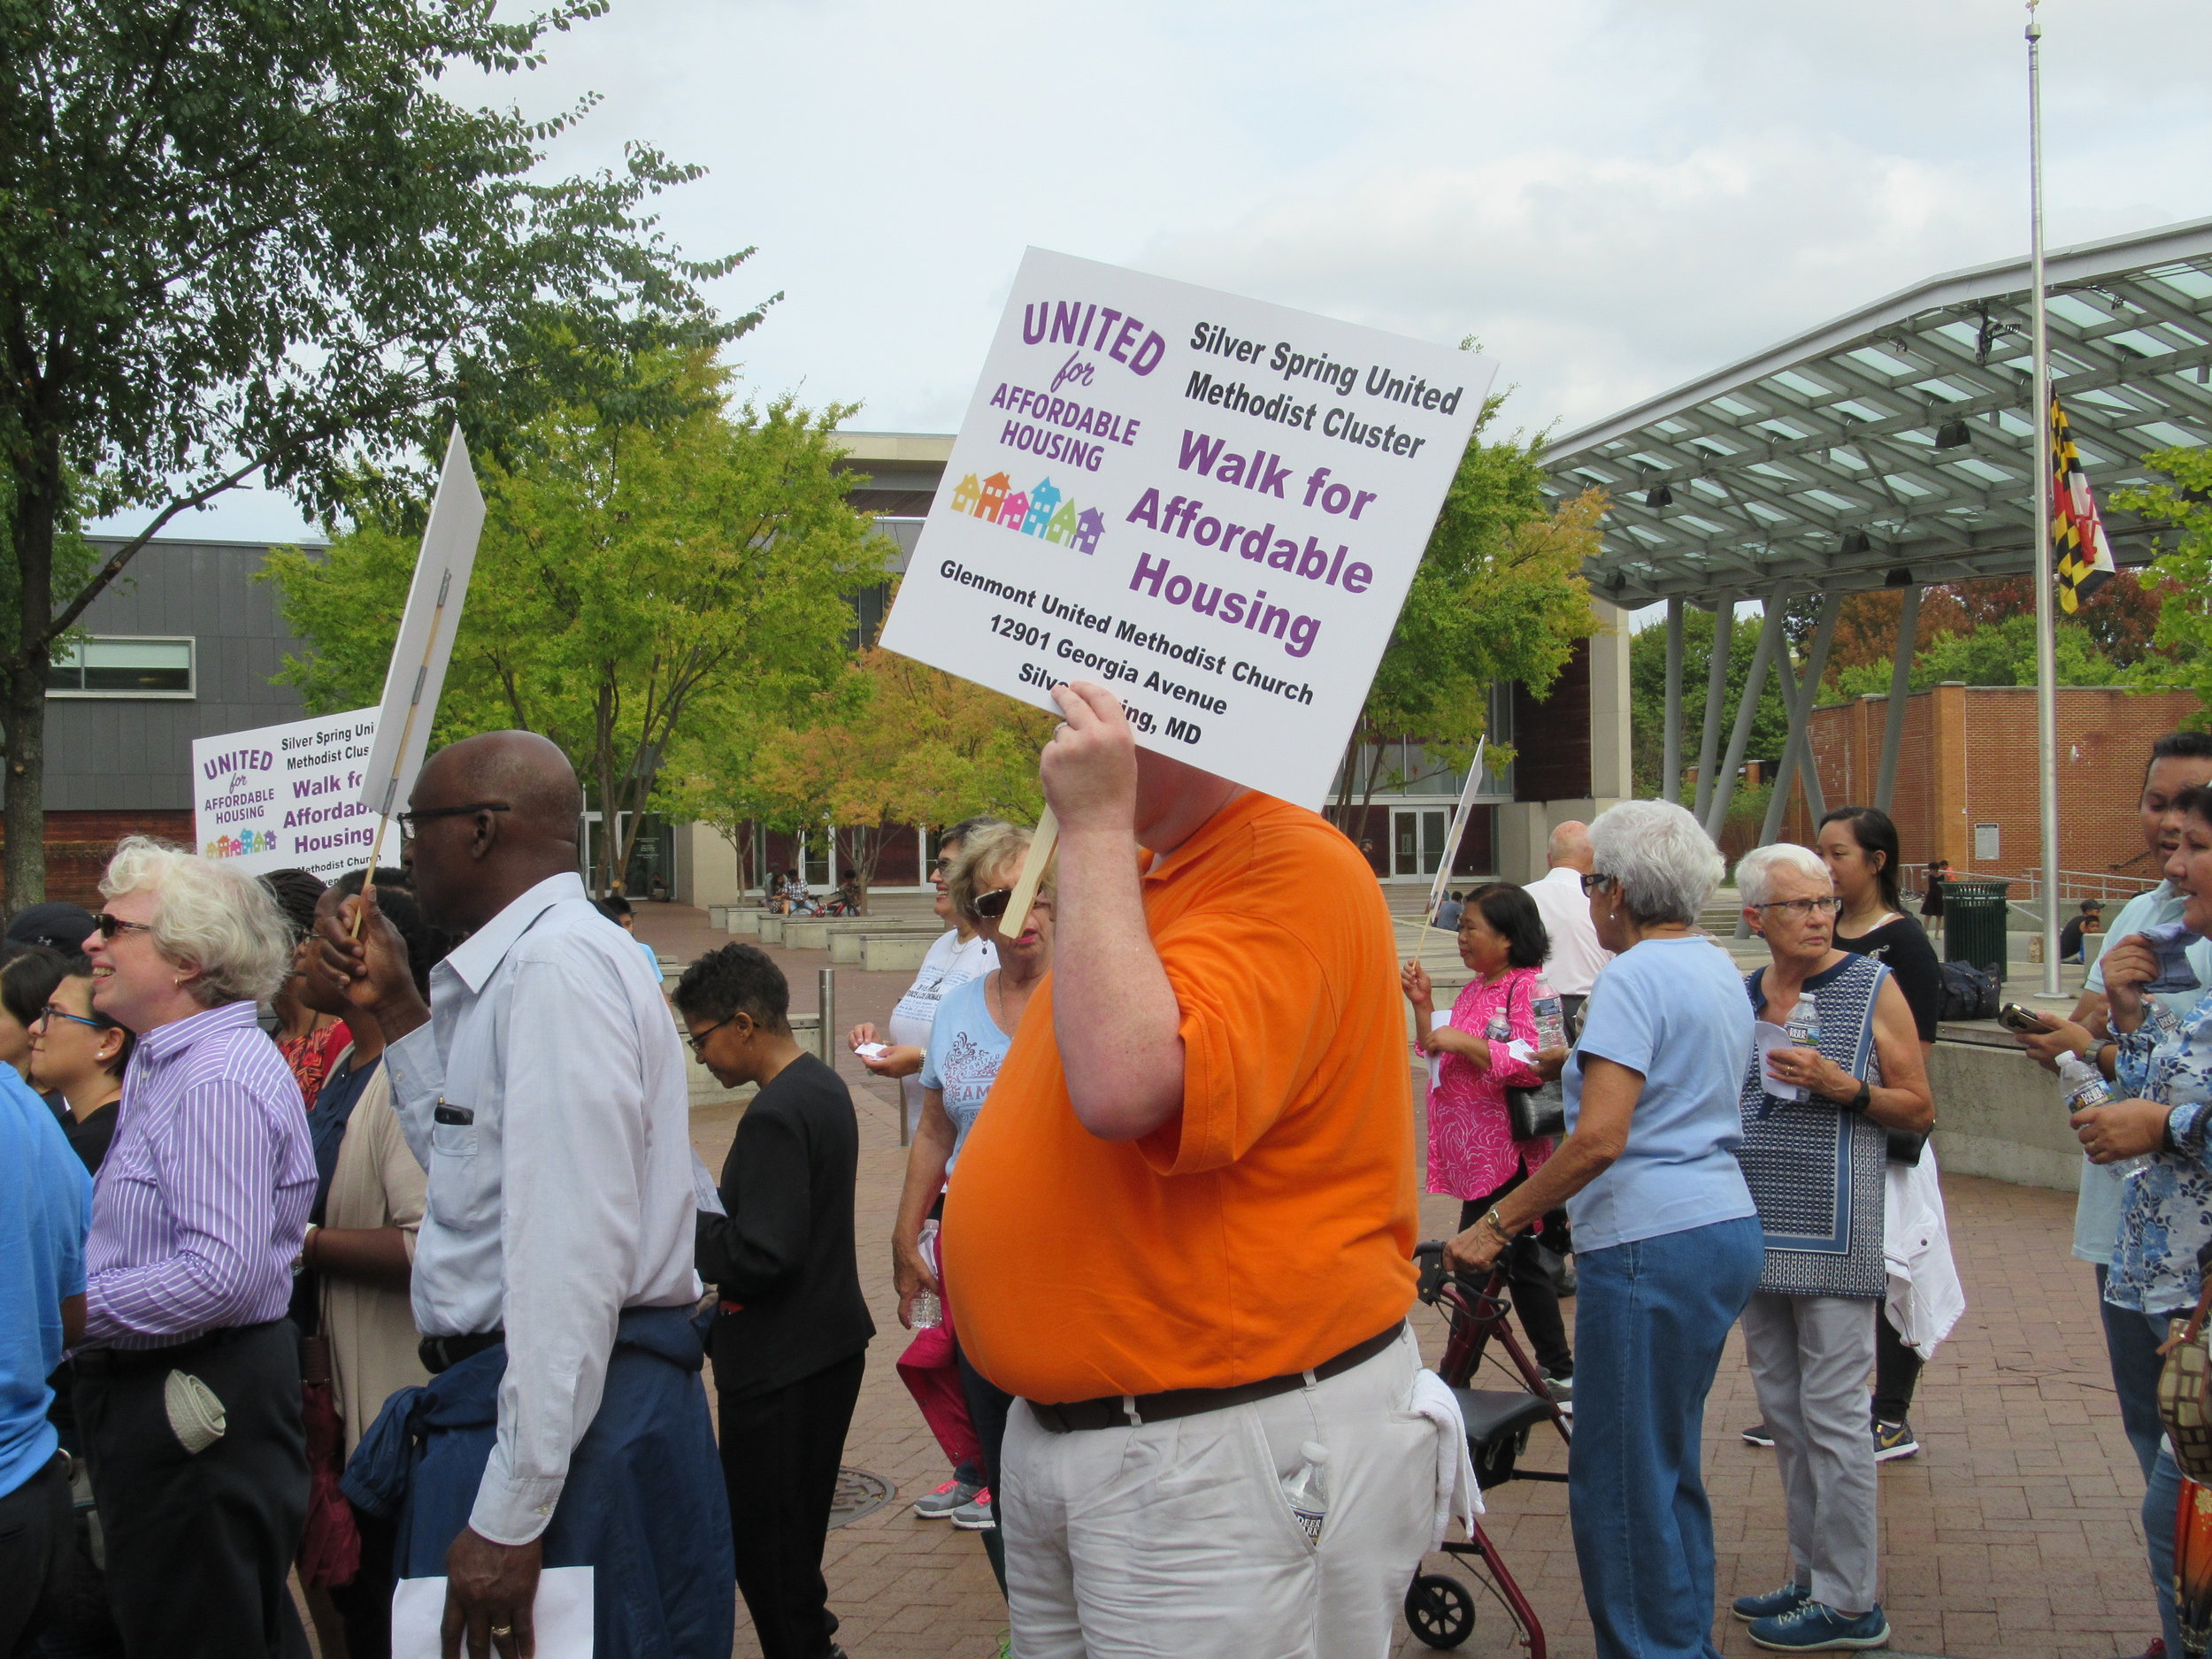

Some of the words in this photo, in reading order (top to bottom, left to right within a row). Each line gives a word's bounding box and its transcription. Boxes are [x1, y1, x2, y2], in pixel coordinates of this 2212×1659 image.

[1023, 301, 1166, 377] UNITED
[1050, 350, 1095, 394] for
[1190, 321, 1267, 365] Silver
[1270, 342, 1359, 396] Spring
[1365, 365, 1463, 416] United
[989, 382, 1141, 447] AFFORDABLE
[1184, 370, 1317, 431] Methodist
[1323, 408, 1426, 459] Cluster
[1000, 419, 1105, 472] HOUSING
[1178, 429, 1294, 499] Walk
[1302, 467, 1378, 521] for
[1125, 487, 1373, 594] Affordable
[1128, 551, 1322, 658] Housing
[940, 559, 1037, 609] Glenmont
[1041, 594, 1112, 634] United
[1114, 619, 1226, 675] Methodist
[1232, 661, 1314, 706] Church
[991, 614, 1051, 651] 12901
[1056, 638, 1139, 684] Georgia
[1142, 671, 1227, 715] Avenue
[1018, 663, 1069, 691] Silv
[1119, 699, 1157, 734] ing,
[1164, 716, 1202, 745] MD
[281, 736, 313, 751] Silver
[316, 728, 352, 747] Spring
[355, 722, 374, 737] Uni
[204, 749, 273, 780] UNITED
[287, 749, 342, 771] Methodist
[344, 745, 370, 759] Clus
[204, 787, 275, 811] AFFORDABLE
[229, 772, 248, 795] for
[292, 774, 342, 799] Walk
[347, 770, 363, 788] fo
[216, 804, 265, 825] HOUSING
[282, 801, 373, 829] Affordab
[295, 827, 374, 855] Housing
[962, 1085, 992, 1102] AM
[1298, 1515, 1321, 1528] DEER
[1303, 1525, 1319, 1536] RK
